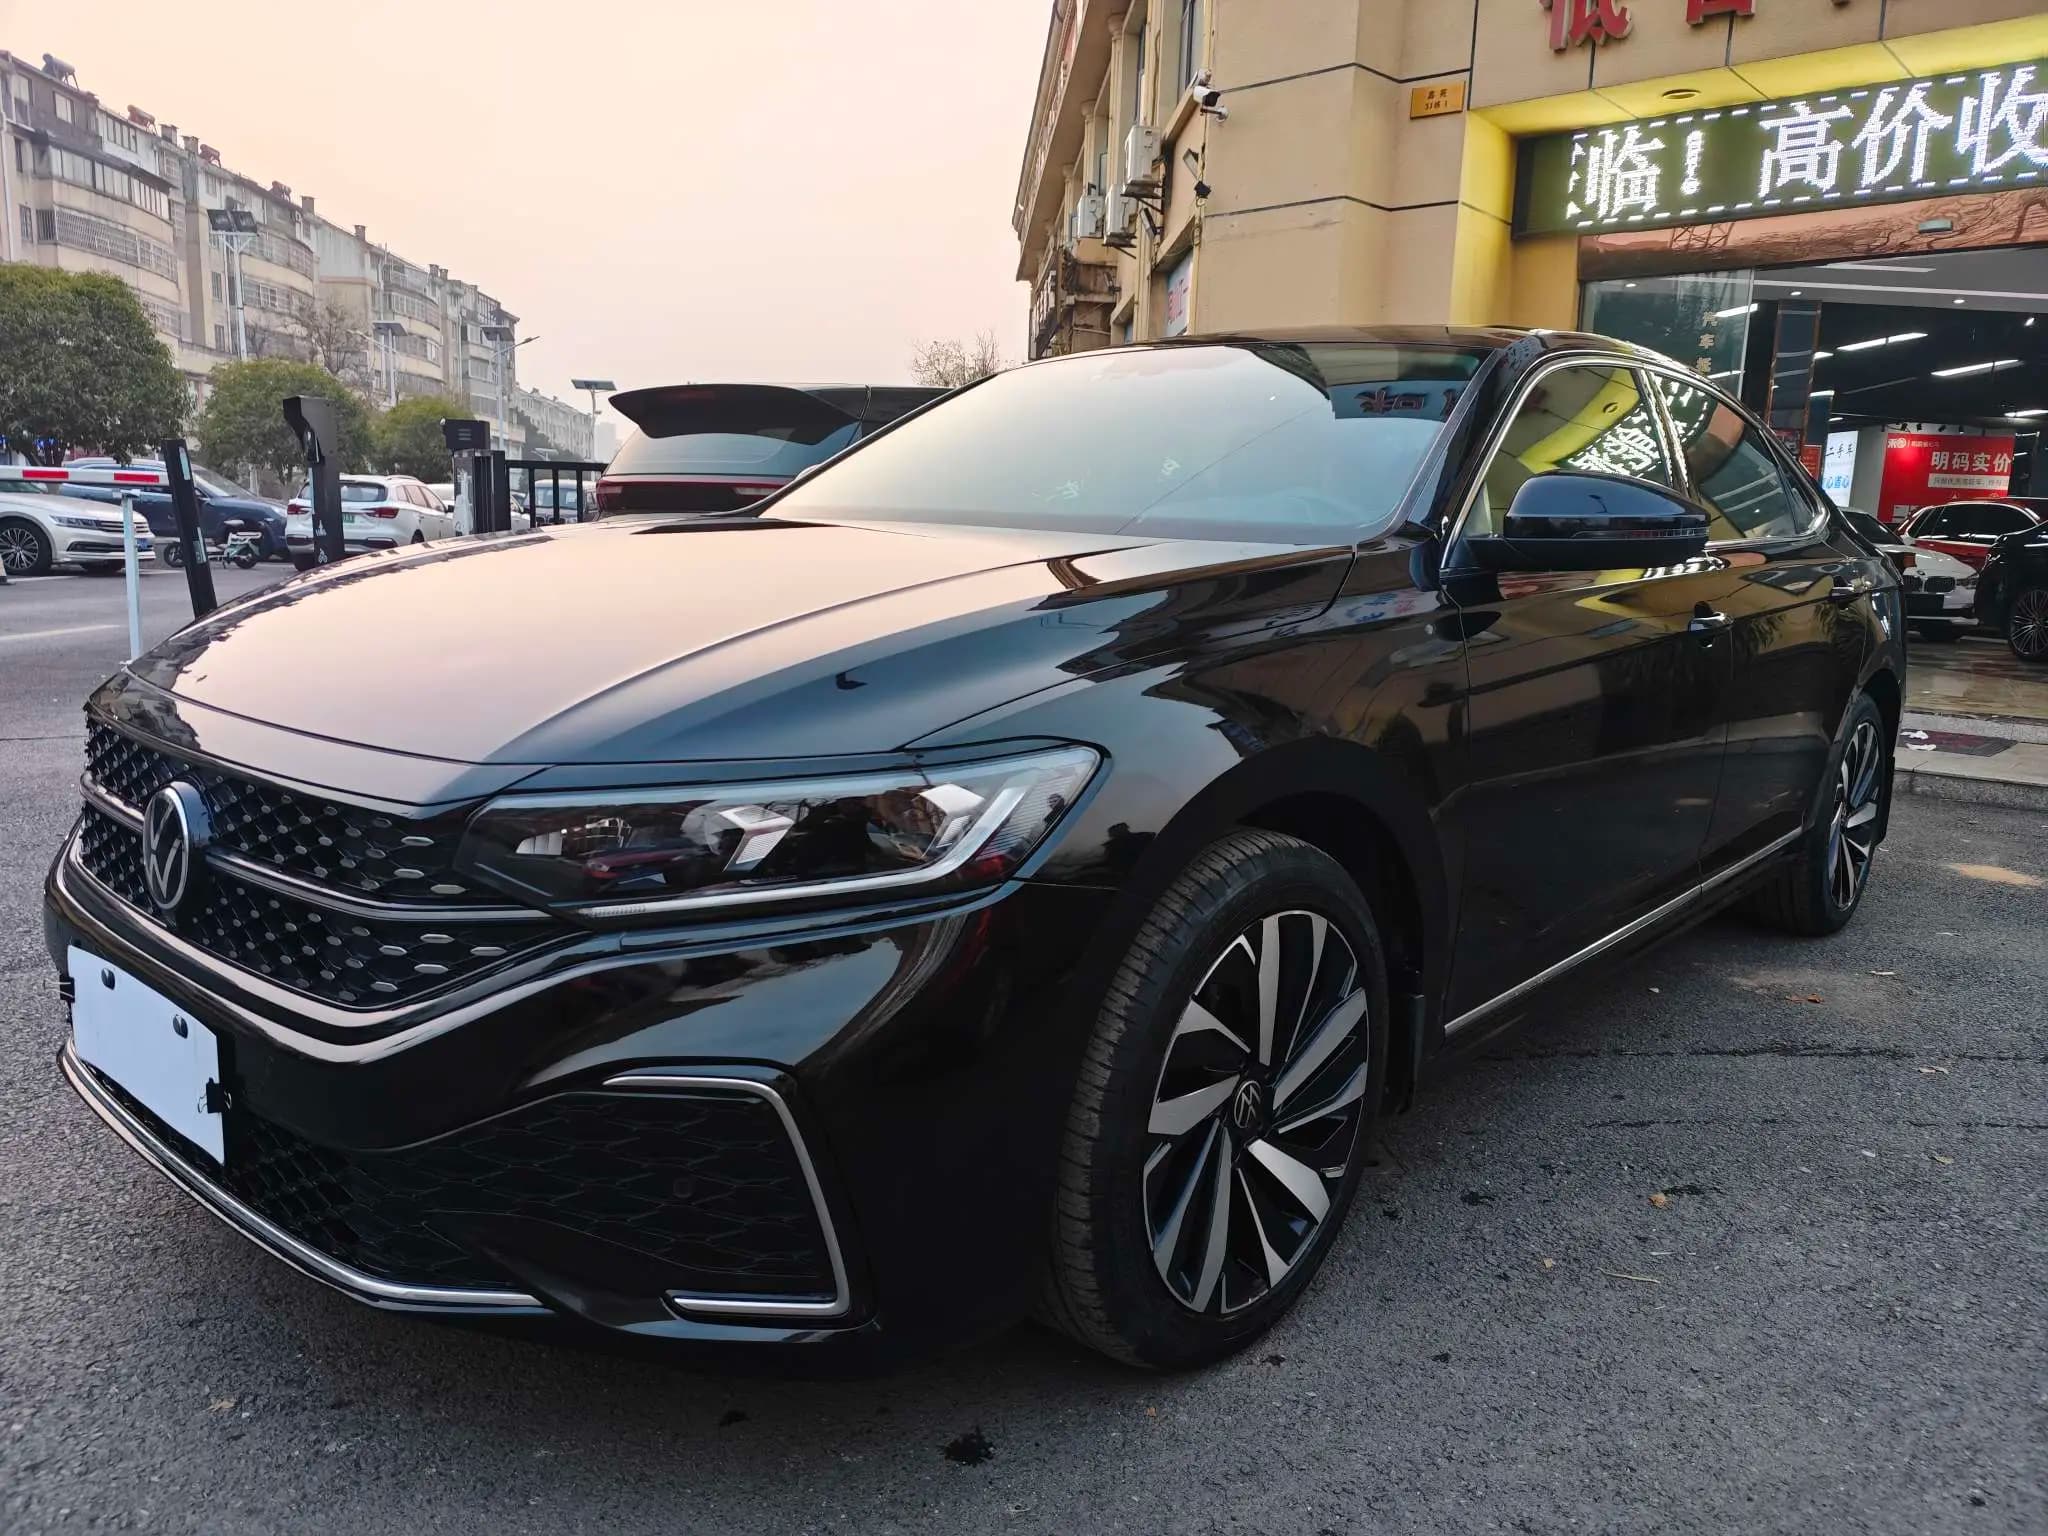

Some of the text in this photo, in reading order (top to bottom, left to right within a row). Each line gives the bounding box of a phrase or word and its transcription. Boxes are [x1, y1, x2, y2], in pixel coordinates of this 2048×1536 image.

[1566, 66, 2048, 220] 临！高价收
[1930, 451, 2012, 473] 明码实价
